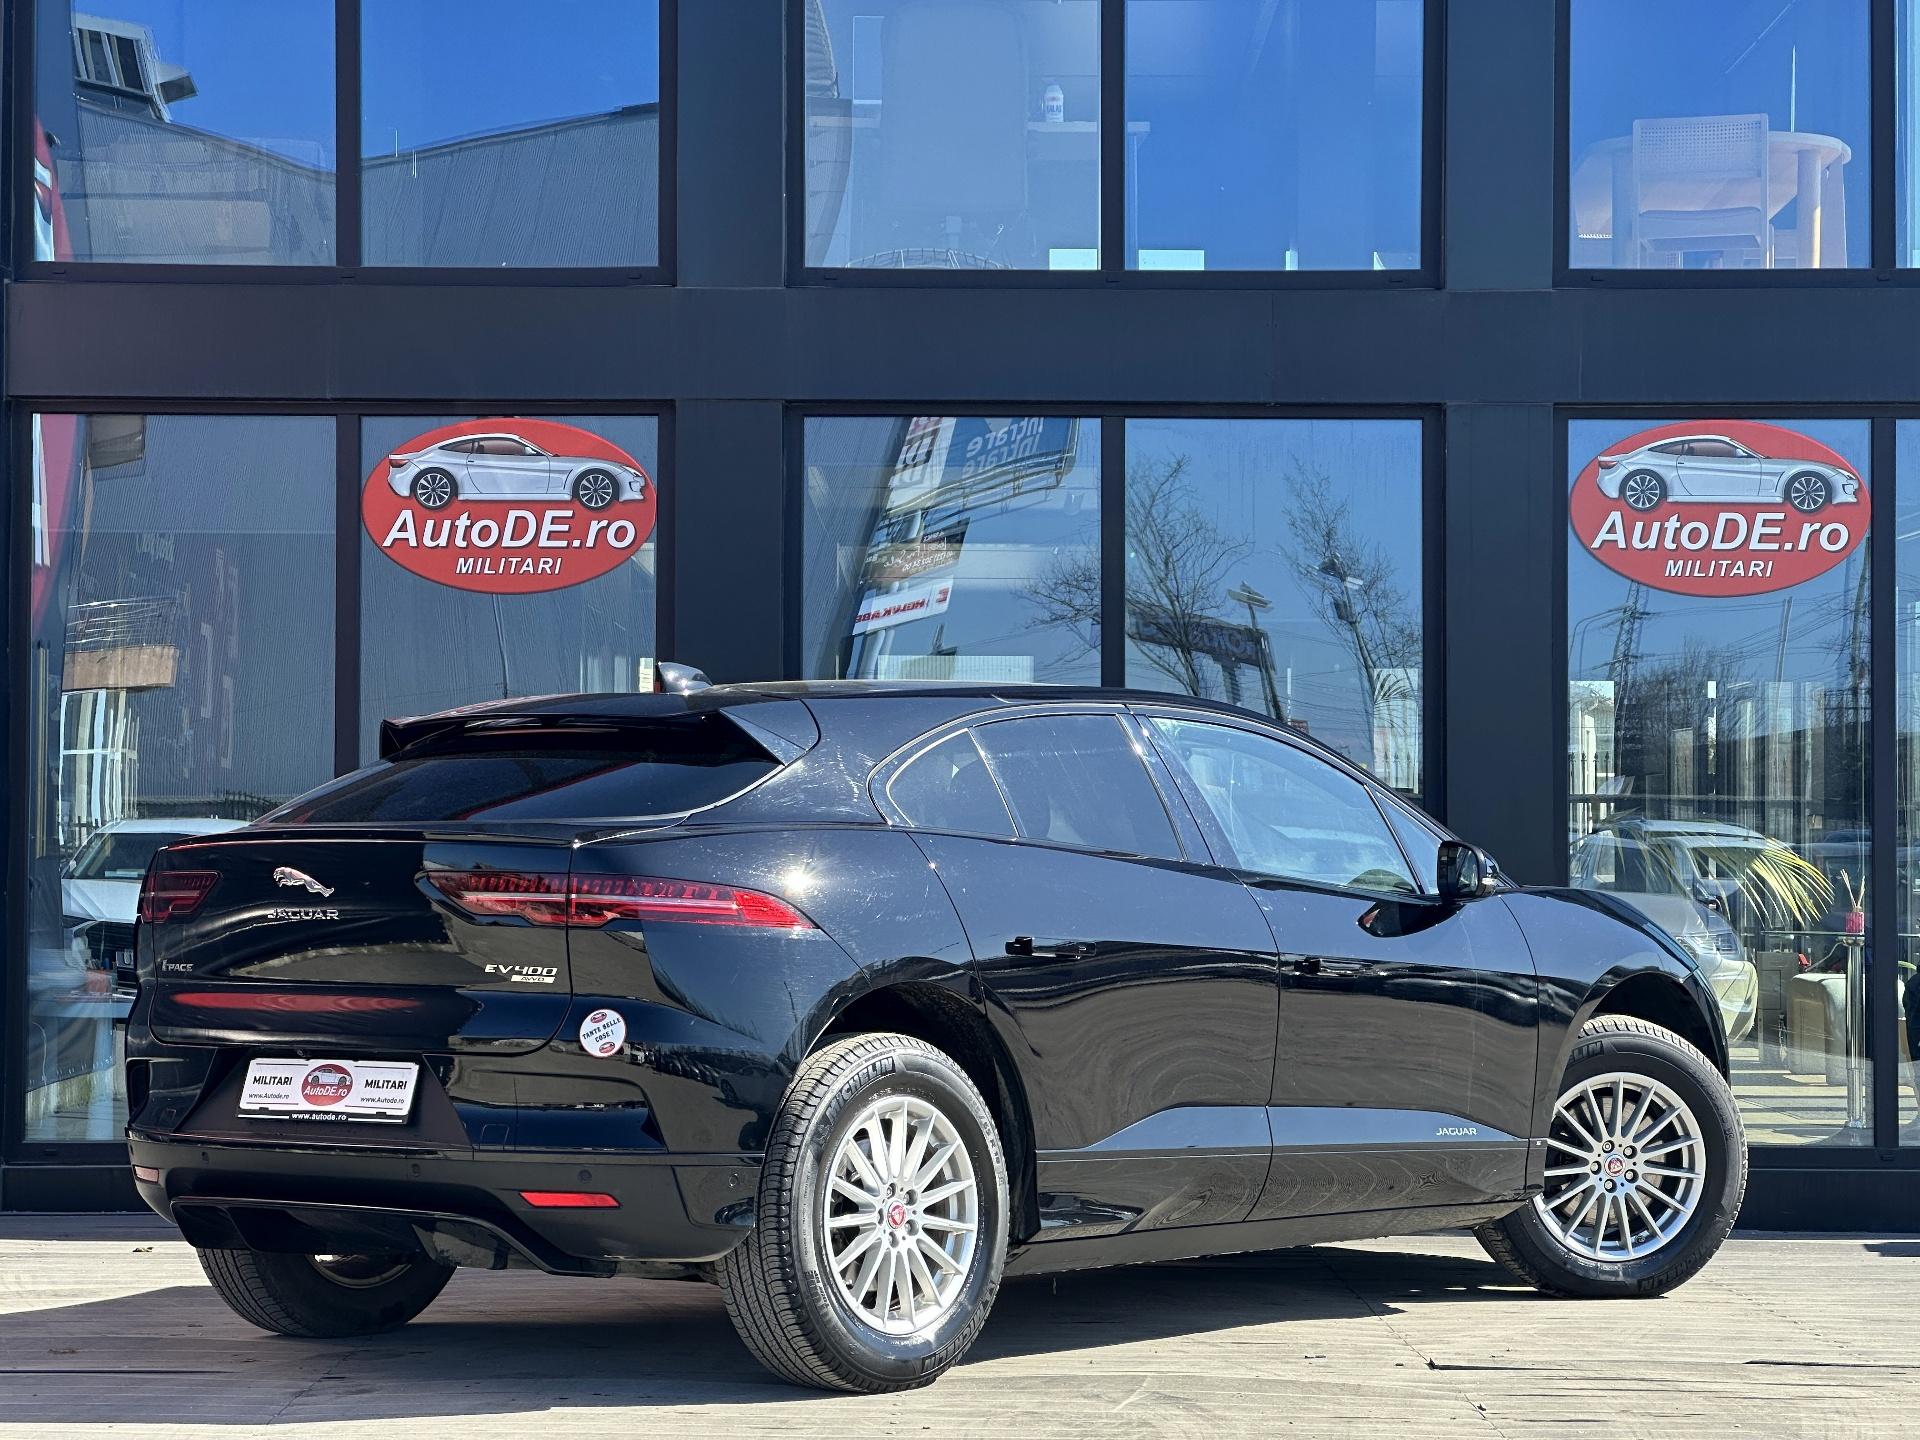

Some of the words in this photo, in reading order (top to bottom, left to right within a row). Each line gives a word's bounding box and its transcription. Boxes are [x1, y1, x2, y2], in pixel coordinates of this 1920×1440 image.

[382, 509, 636, 549] AutoDE.ro
[1590, 511, 1849, 551] AutoDE.ro
[455, 557, 562, 575] MILITARI
[1664, 559, 1773, 577] MILITARI
[267, 908, 339, 920] JAGUAR
[582, 1026, 602, 1040] TANTE
[602, 1017, 622, 1031] BELLE
[252, 1075, 293, 1086] MILITARI
[364, 1079, 407, 1090] MILITARI
[303, 1085, 348, 1098] AutoDE.ro
[826, 1057, 895, 1126] MICHELIN
[291, 1112, 347, 1121] www.autode.ro
[1436, 1127, 1478, 1136] JAGUAR
